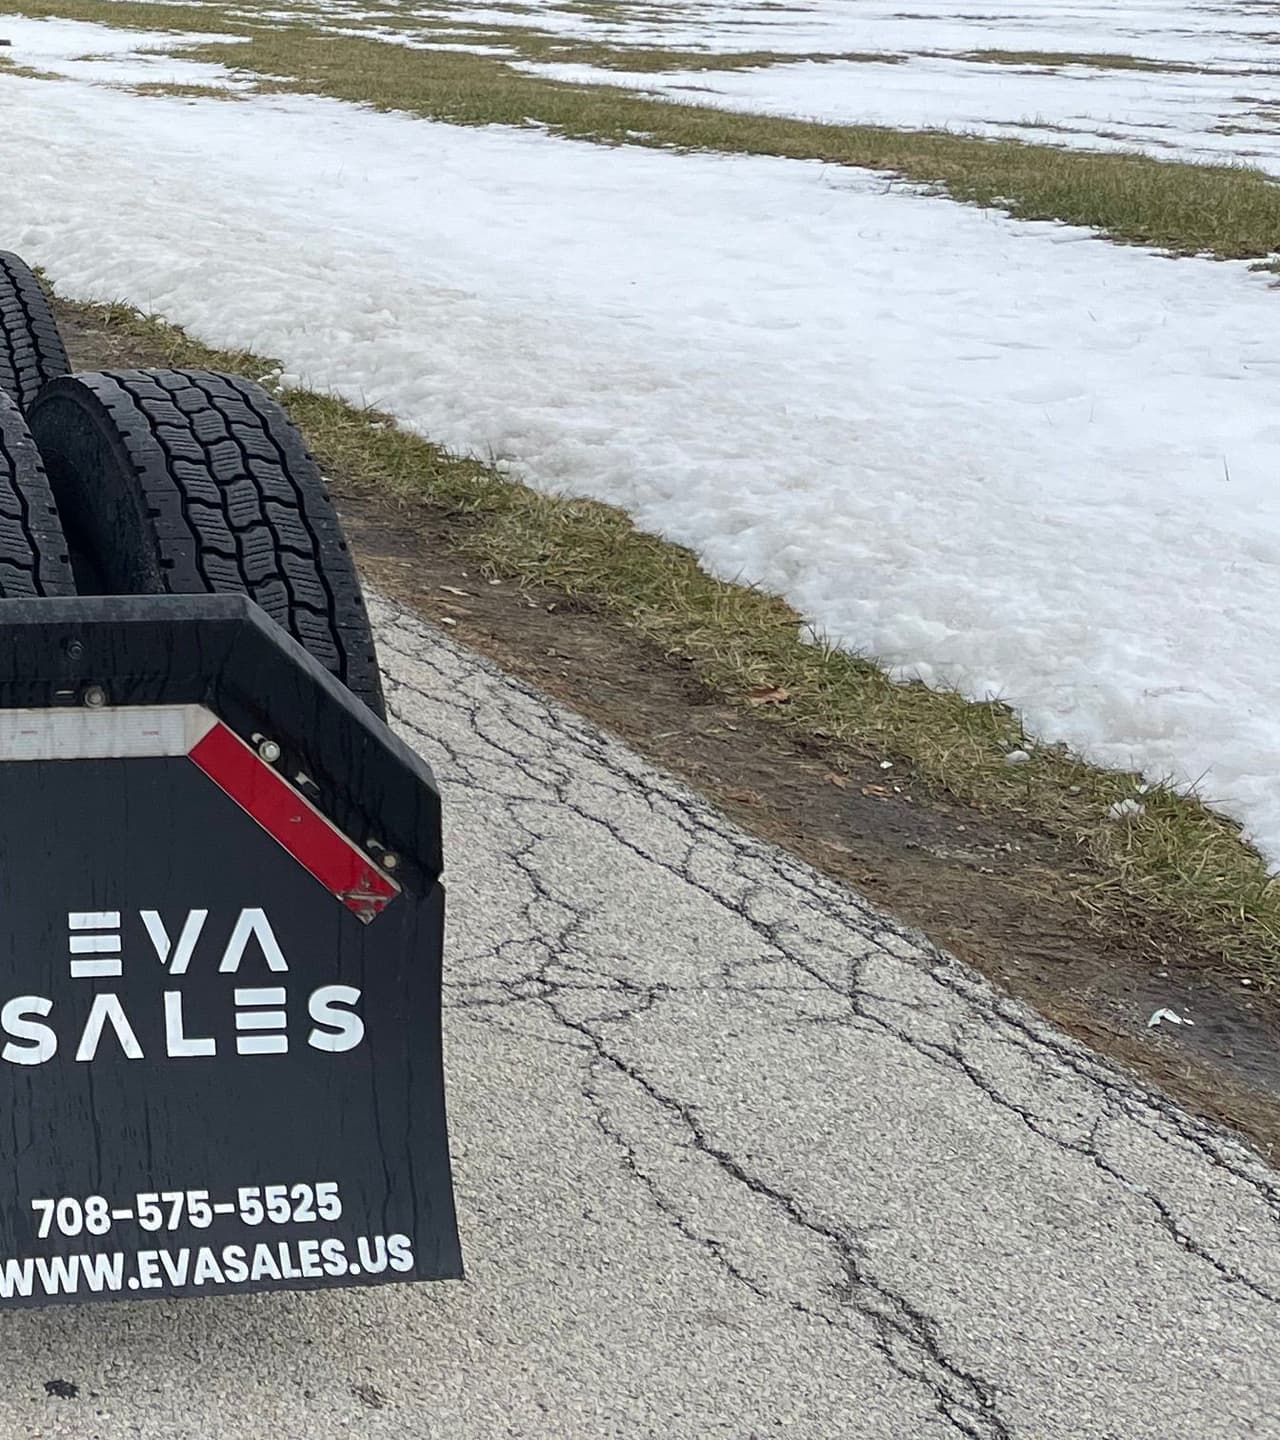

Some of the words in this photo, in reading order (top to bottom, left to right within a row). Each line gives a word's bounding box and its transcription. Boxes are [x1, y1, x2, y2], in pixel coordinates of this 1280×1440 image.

[68, 907, 289, 978] EVA
[0, 985, 365, 1065] SALES
[31, 1182, 343, 1239] 708-575-5525
